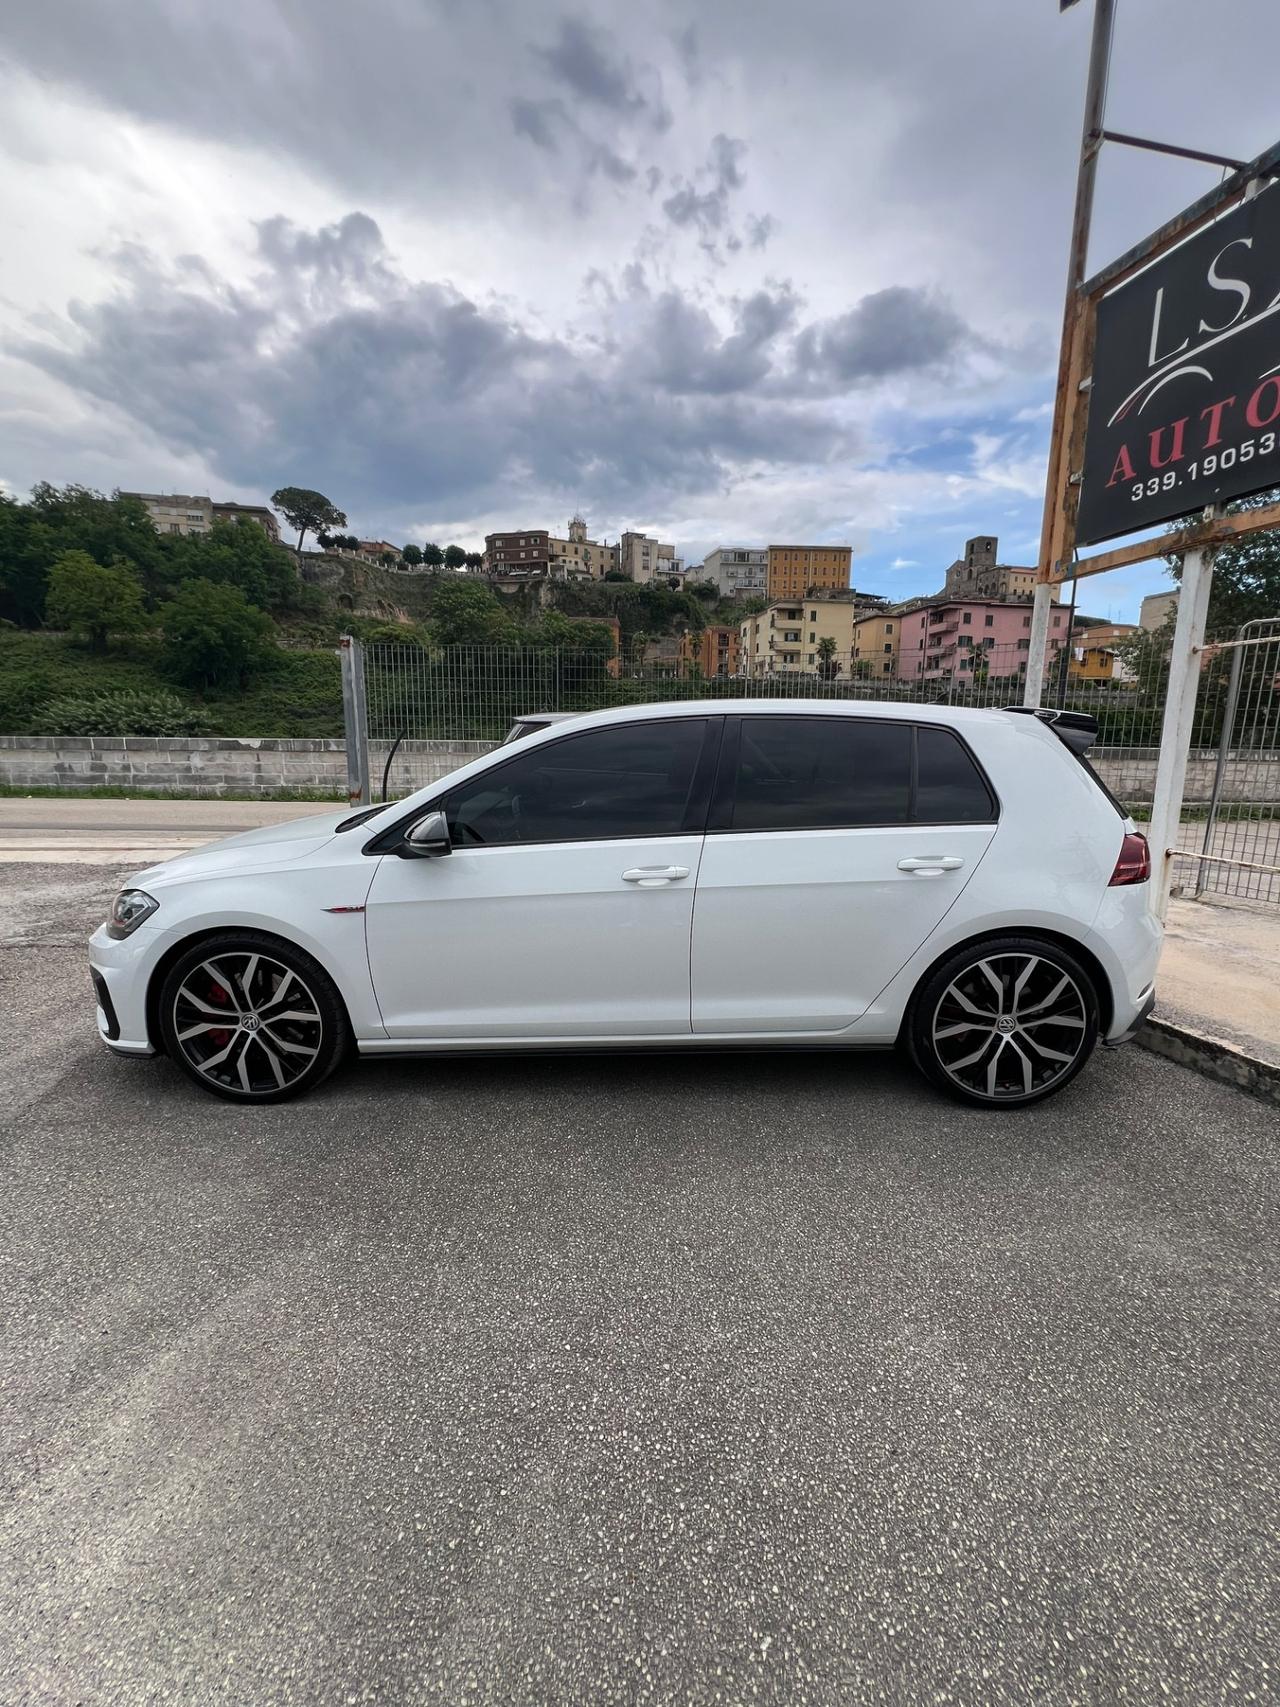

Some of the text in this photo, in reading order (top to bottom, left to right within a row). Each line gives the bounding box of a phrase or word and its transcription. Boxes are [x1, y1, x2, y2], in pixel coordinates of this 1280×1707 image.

[1148, 238, 1280, 367] LS
[1105, 375, 1280, 488] AUTO
[1131, 432, 1280, 501] 339.19053
